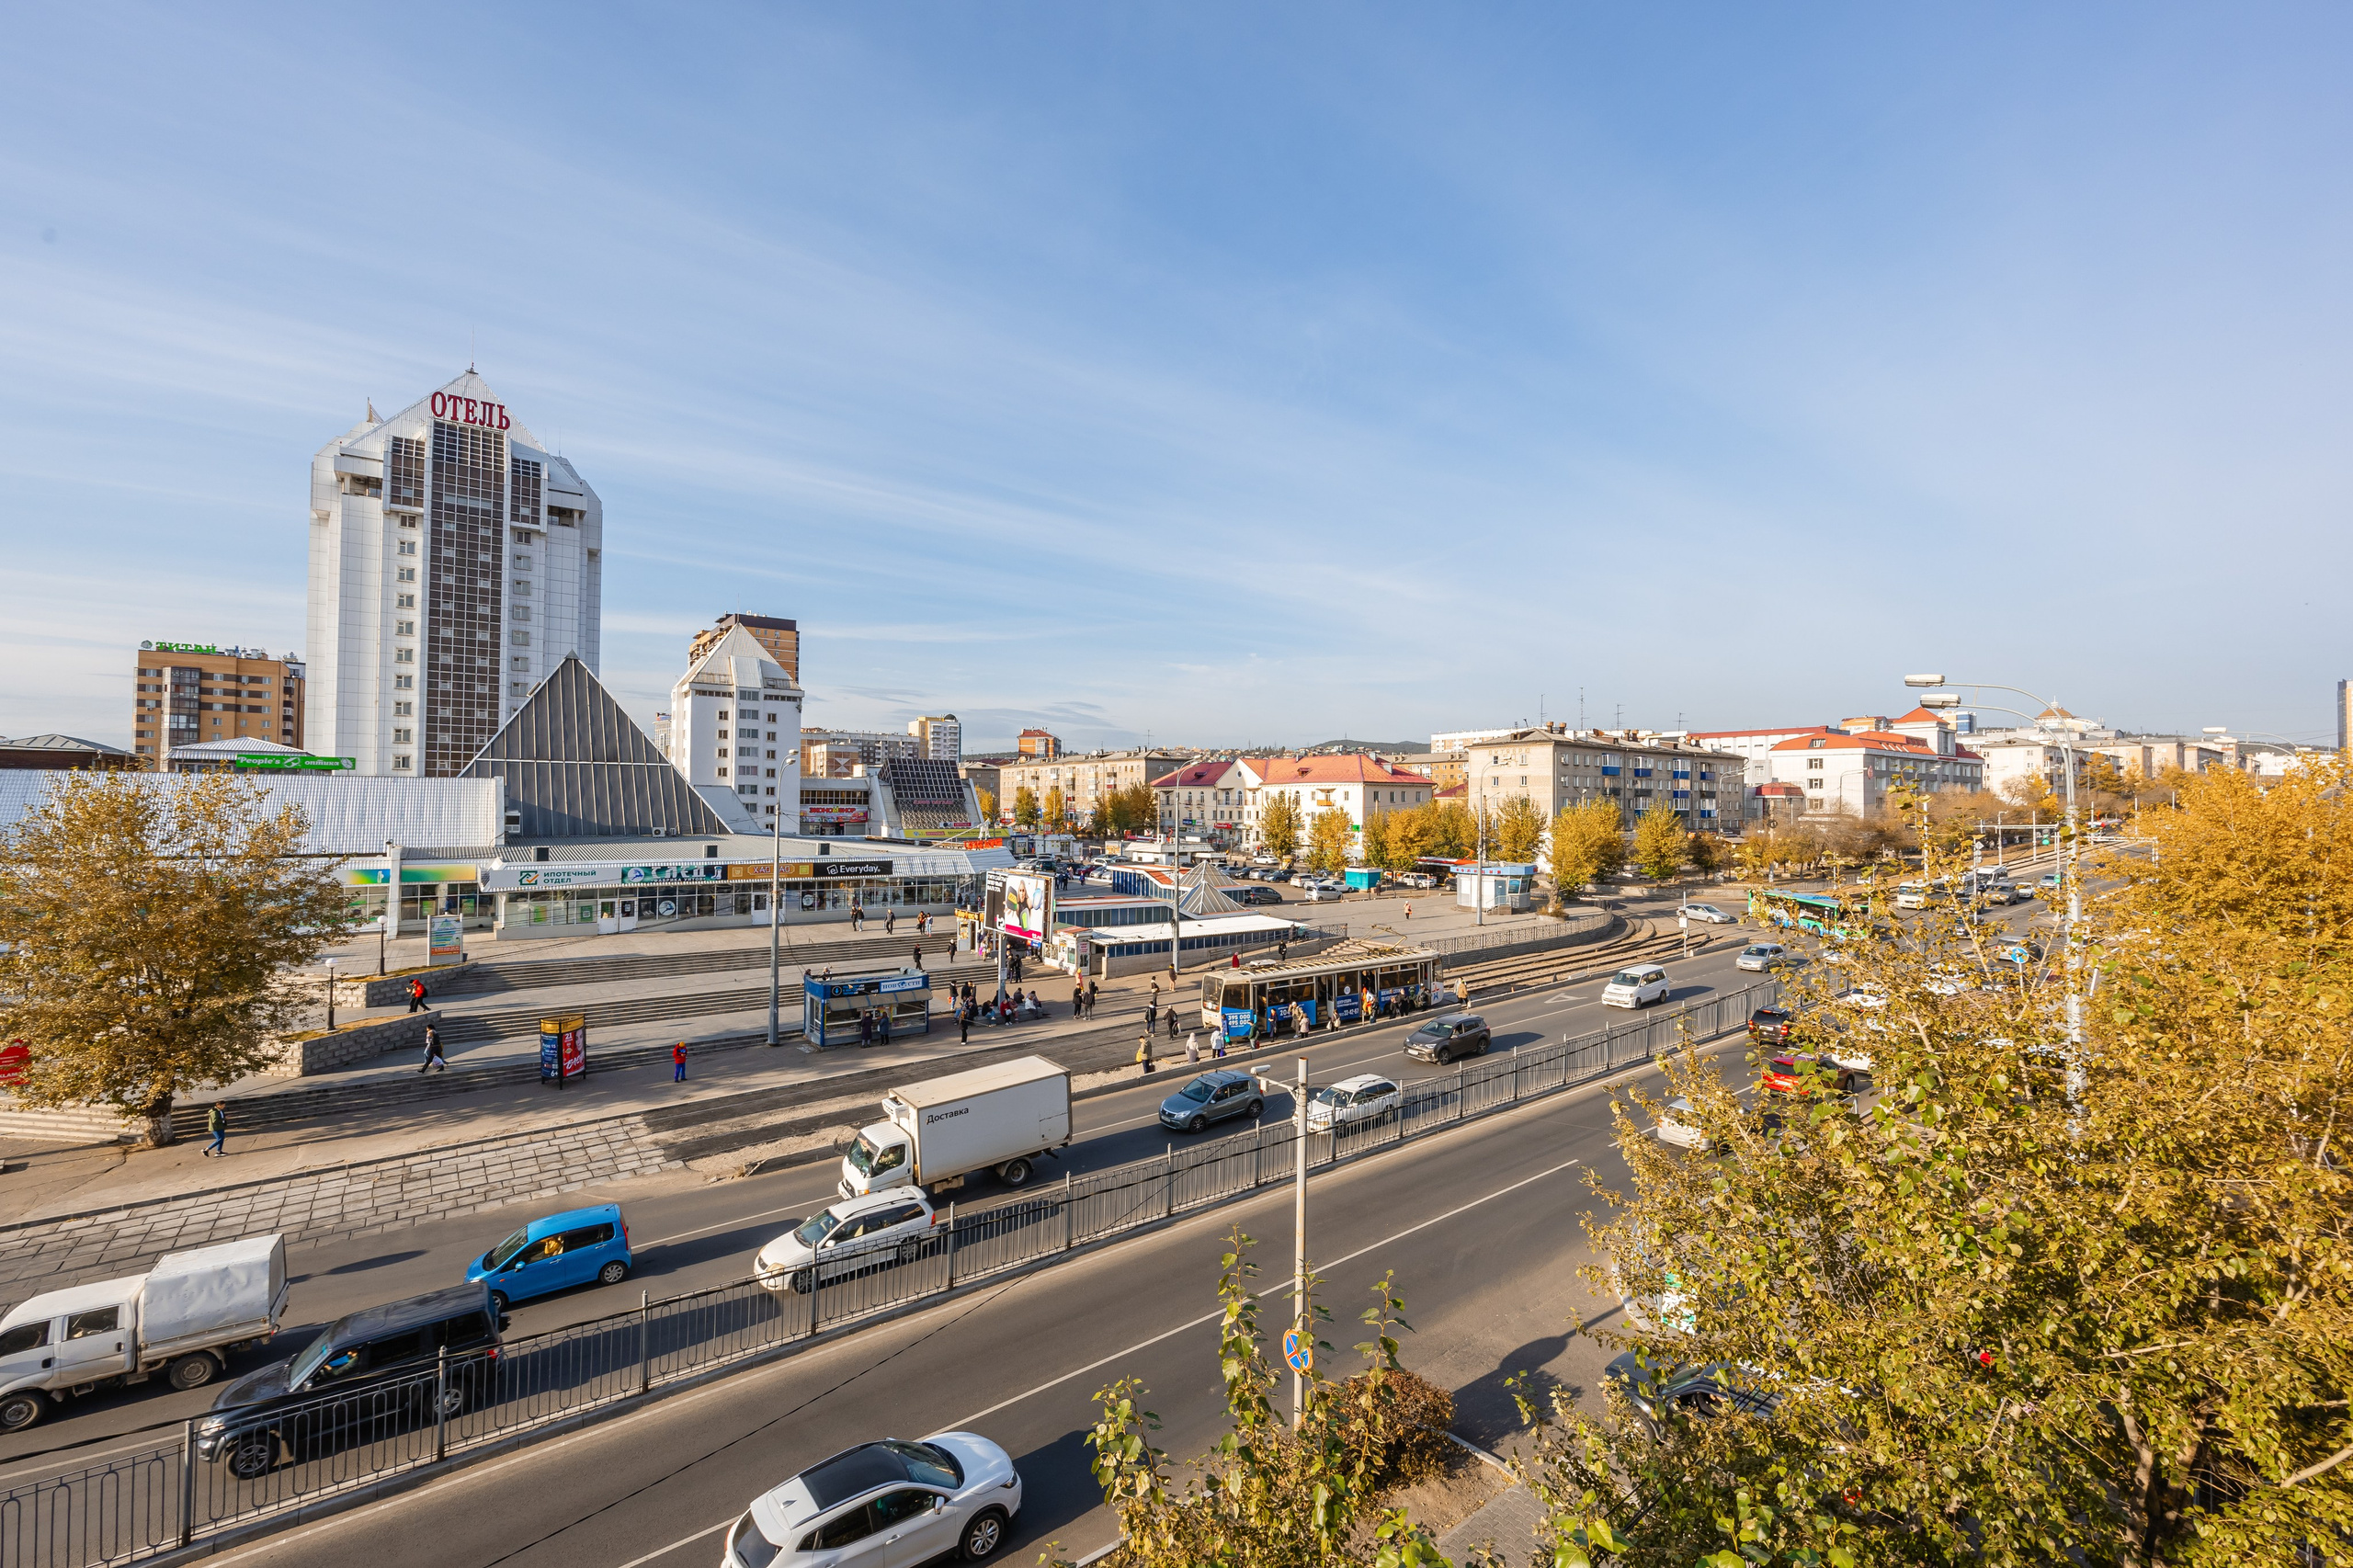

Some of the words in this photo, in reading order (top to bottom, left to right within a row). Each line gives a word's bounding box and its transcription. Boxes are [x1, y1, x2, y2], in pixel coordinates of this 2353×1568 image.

[431, 391, 510, 430] ОТЕЛЬ
[155, 642, 217, 653] ТИТАН
[238, 756, 280, 765] People's
[543, 869, 597, 878] ИПОТЕЧНЫЙ
[926, 1108, 969, 1125] Доставка
